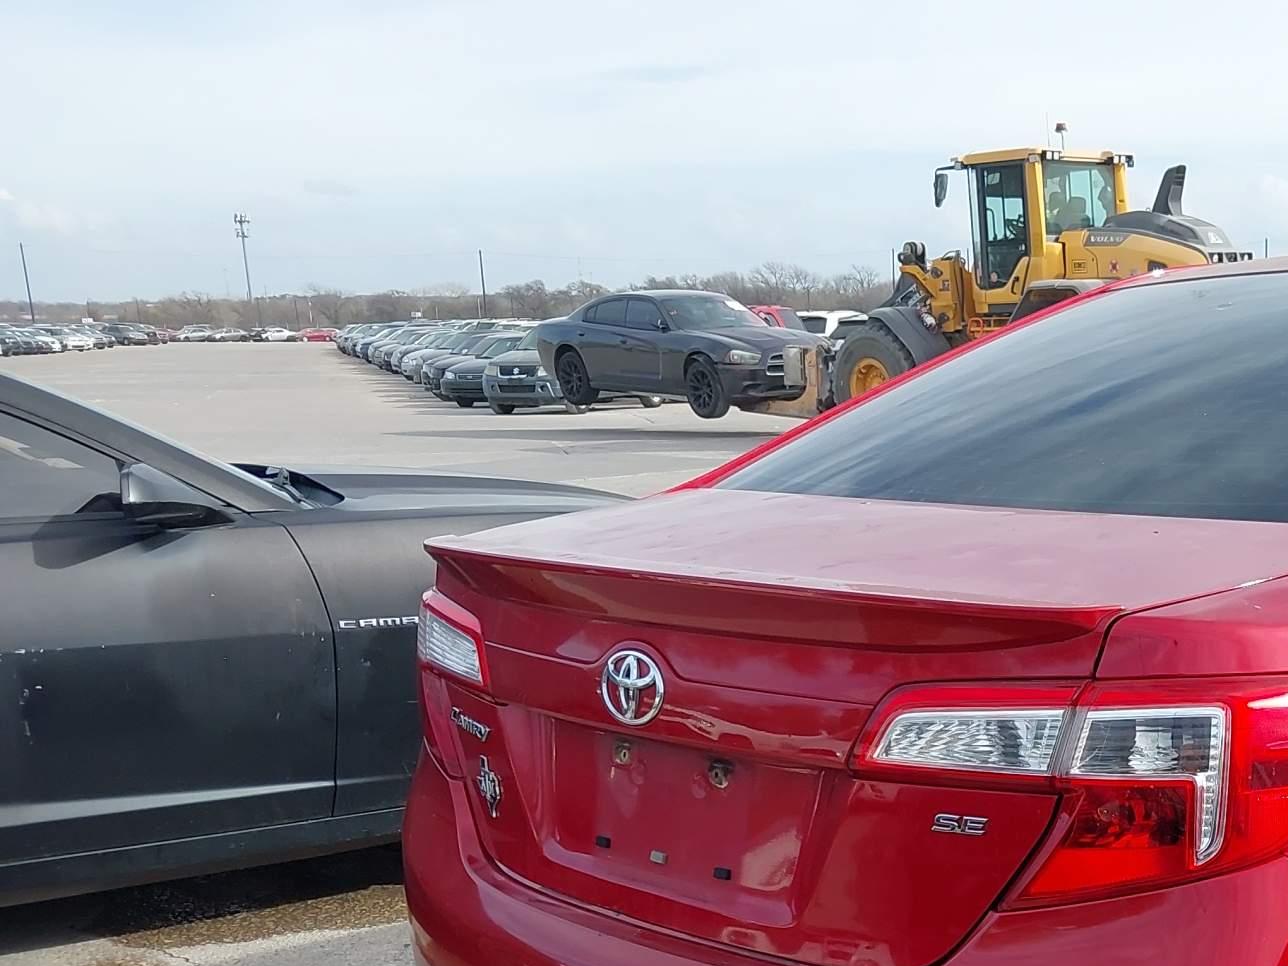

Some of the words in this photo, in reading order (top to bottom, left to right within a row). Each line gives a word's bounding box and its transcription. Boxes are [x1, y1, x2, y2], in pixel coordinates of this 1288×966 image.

[1089, 235, 1124, 243] VOLVO
[450, 706, 490, 742] CAMRY
[931, 813, 989, 836] SE
